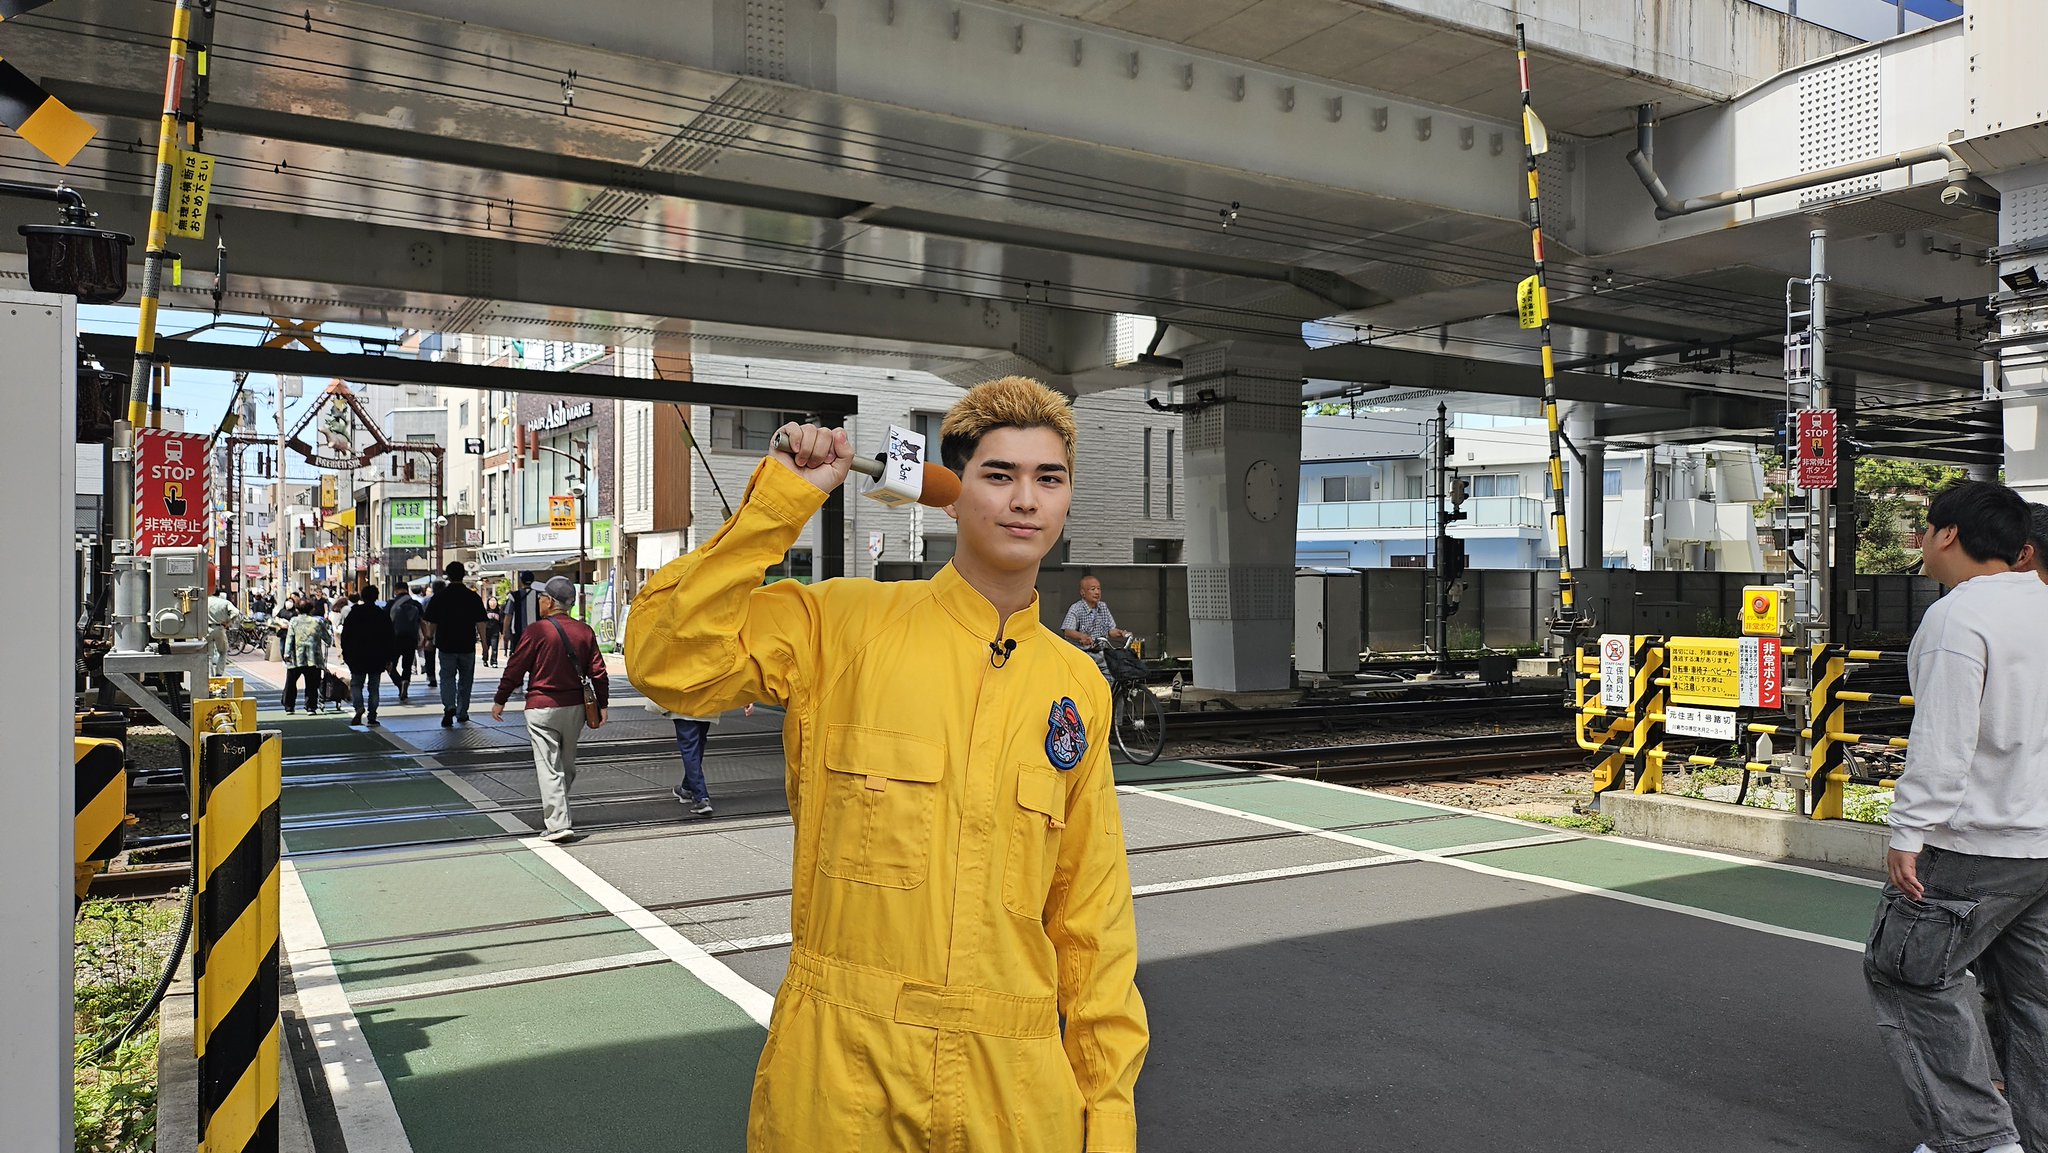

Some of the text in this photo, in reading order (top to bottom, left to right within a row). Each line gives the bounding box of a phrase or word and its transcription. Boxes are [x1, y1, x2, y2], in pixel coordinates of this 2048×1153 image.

[178, 156, 196, 231] 無理な横断は
[190, 160, 209, 232] おやめ下さい
[528, 400, 592, 433] HAIR Ash MAKE
[1805, 429, 1829, 438] STOP
[1802, 458, 1832, 466] 非常停止
[1805, 466, 1828, 474] ボタン
[151, 465, 195, 480] STOP
[145, 517, 201, 533] 非常停止
[152, 533, 194, 546] ボタン
[1763, 642, 1776, 703] 非常ボタン
[1173, 680, 1180, 688] 2
[1605, 666, 1613, 701] 立入禁止
[1616, 667, 1624, 702] 係員以外
